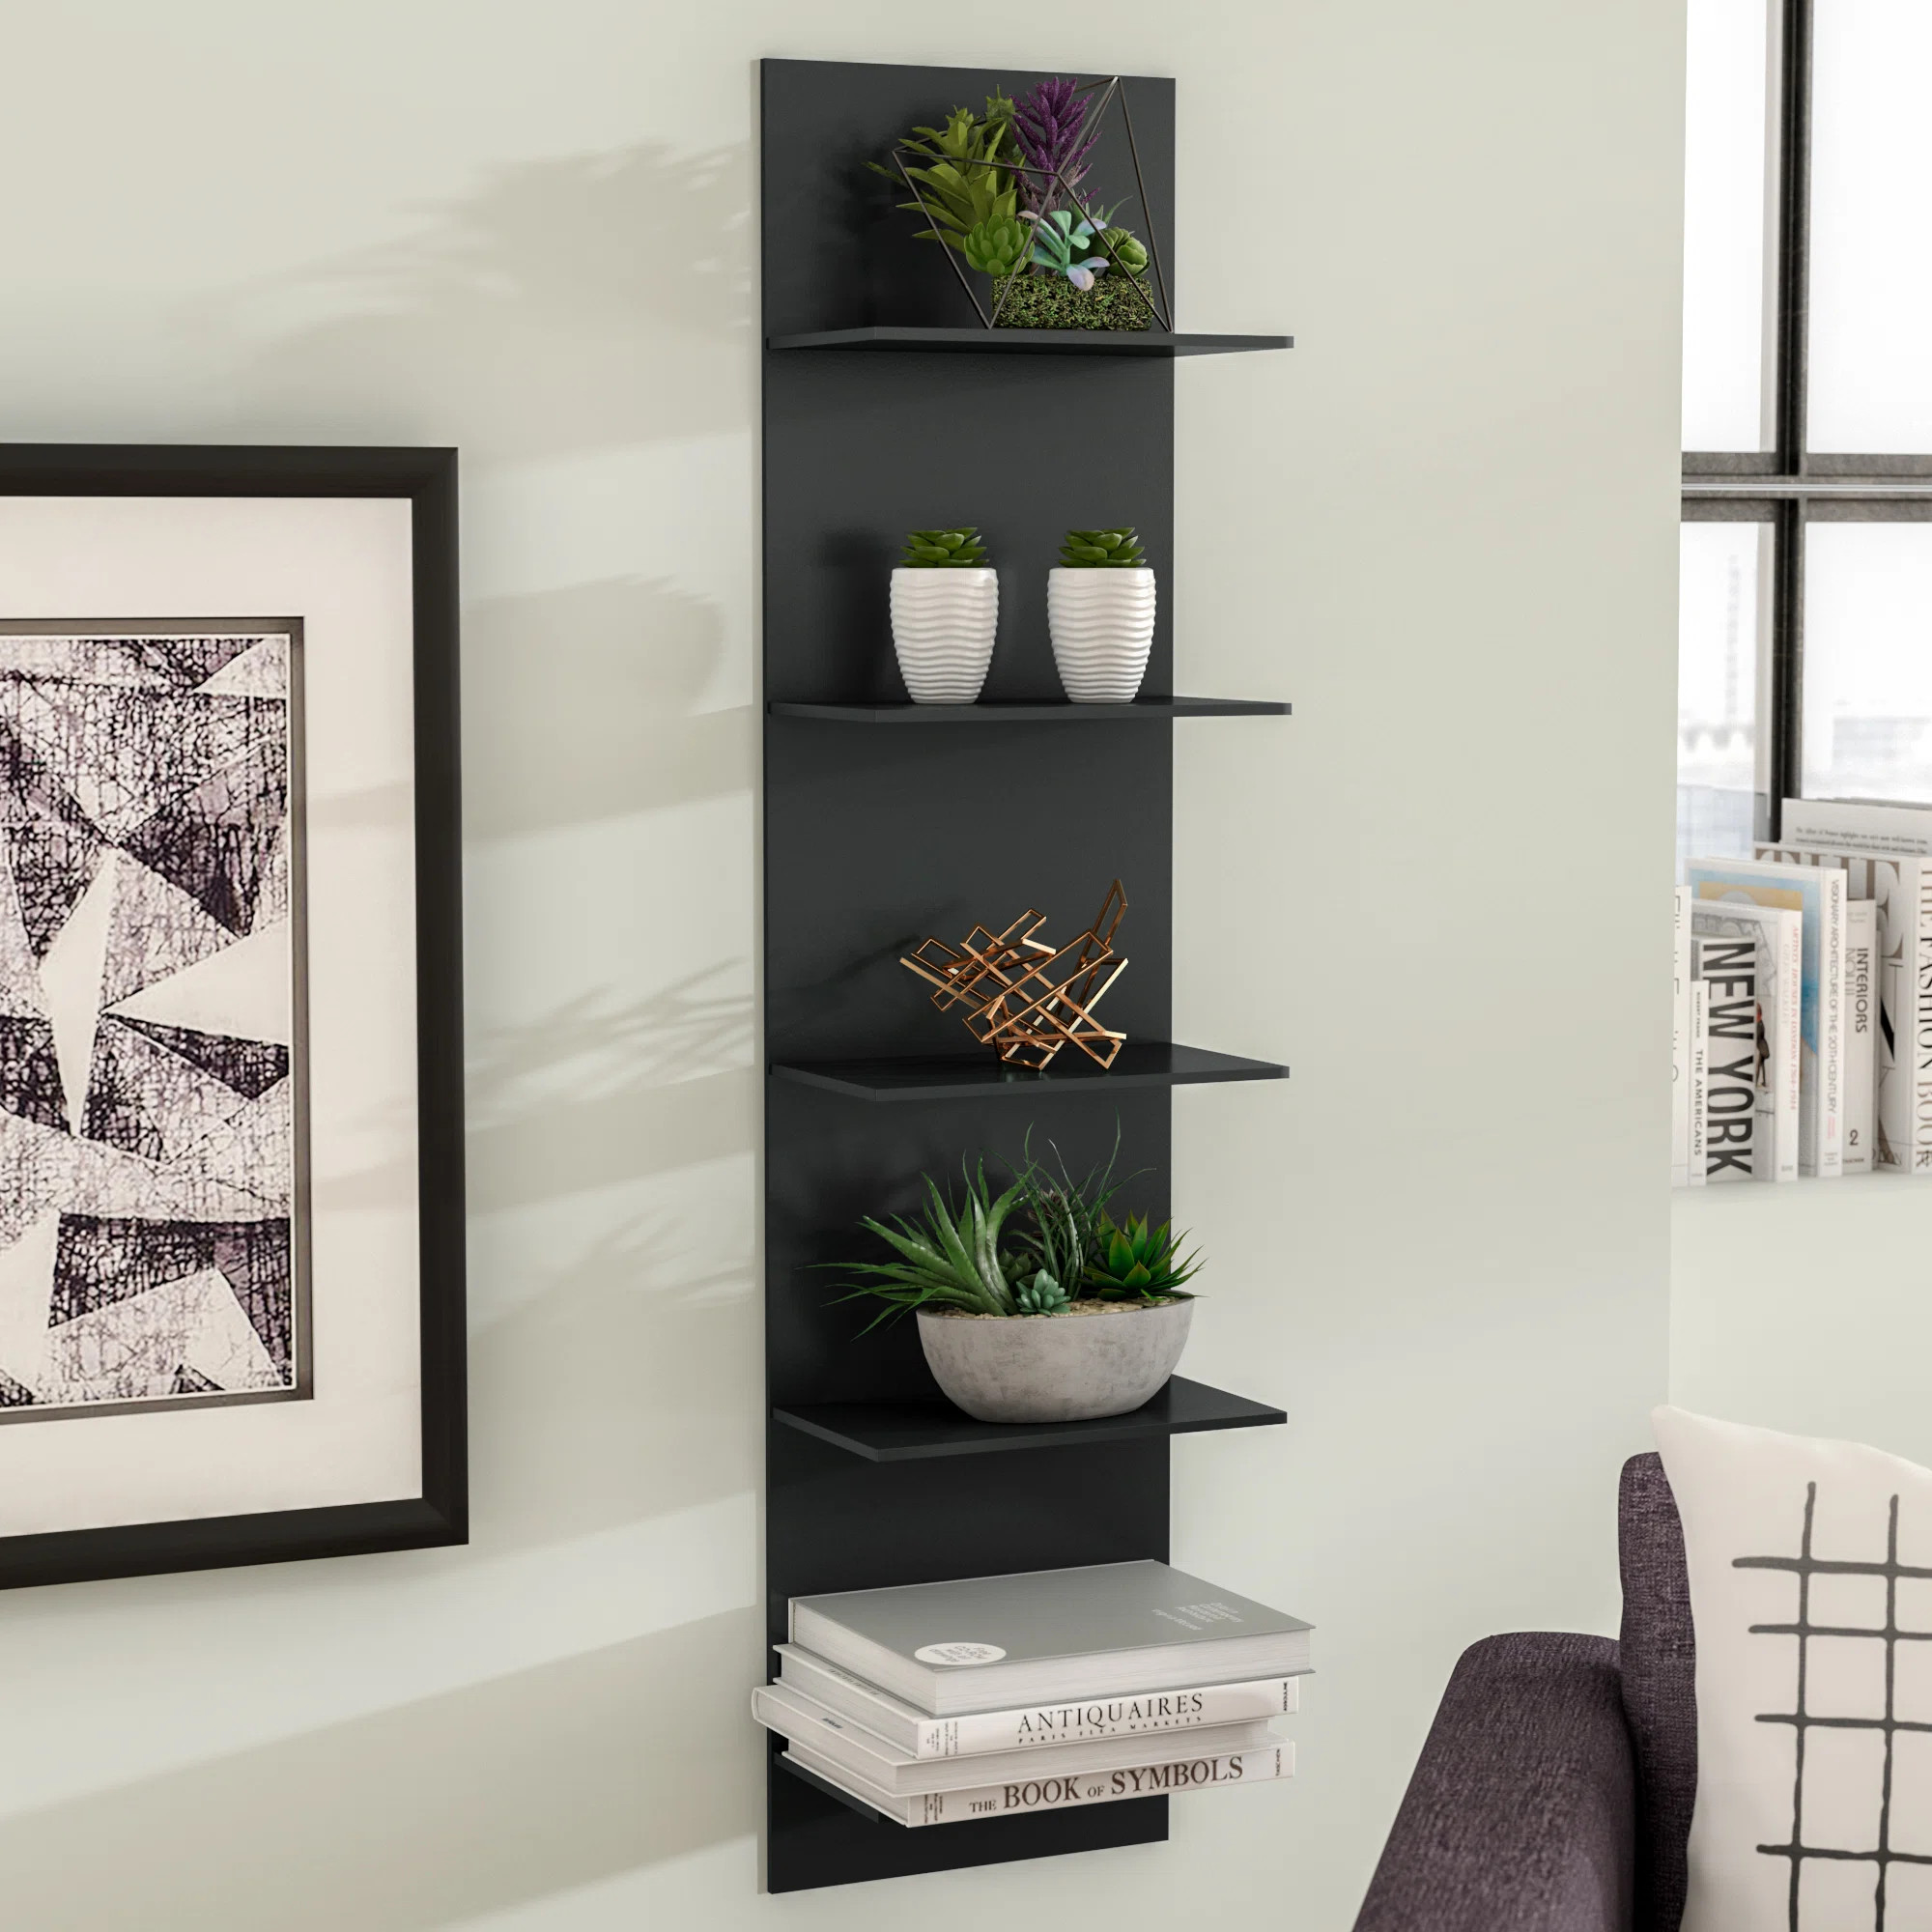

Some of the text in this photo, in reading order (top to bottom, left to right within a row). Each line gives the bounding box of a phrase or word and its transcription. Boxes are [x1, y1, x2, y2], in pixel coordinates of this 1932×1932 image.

[1831, 879, 1839, 924] VISIONARY
[1830, 926, 1839, 997] ARCHITECTURE
[1703, 943, 1755, 1039] NEW
[1829, 999, 1838, 1013] OF
[1856, 948, 1868, 1033] INTERIORS
[1917, 938, 1932, 1069] FASHION
[1829, 1014, 1837, 1034] THE
[1829, 1035, 1837, 1064] 20TH
[1828, 1064, 1837, 1113] CENTURY
[1706, 1055, 1754, 1176] YORK
[1849, 1129, 1859, 1146] 2
[1017, 1692, 1203, 1734] ANTIQUAIRES
[1018, 1733, 1065, 1744] PARIS
[1129, 1716, 1202, 1730] MARKETS
[969, 1800, 997, 1813] THE
[1003, 1776, 1081, 1809] BOOK
[1087, 1785, 1105, 1799] OF
[1111, 1755, 1243, 1796] SYMBOLS
